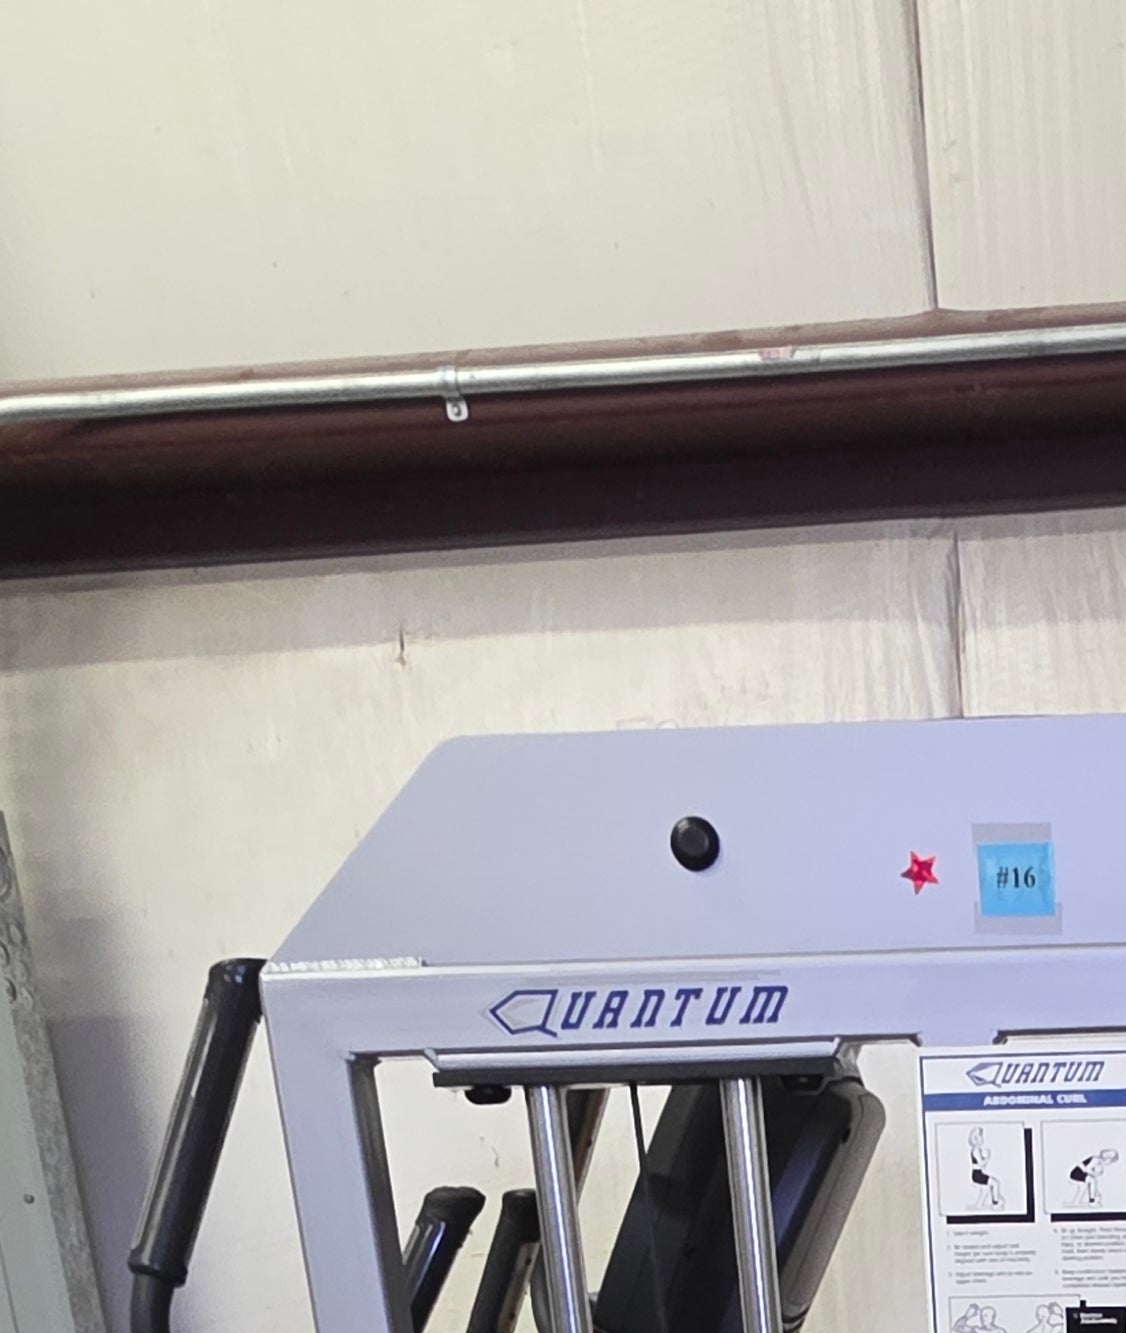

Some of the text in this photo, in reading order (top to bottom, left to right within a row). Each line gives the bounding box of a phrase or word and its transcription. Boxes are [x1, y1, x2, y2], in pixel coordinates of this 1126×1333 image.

[995, 865, 1037, 890] #16
[489, 985, 790, 1038] QUANTUM
[966, 1060, 1106, 1089] QUANTUM
[1056, 1093, 1088, 1105] CURL
